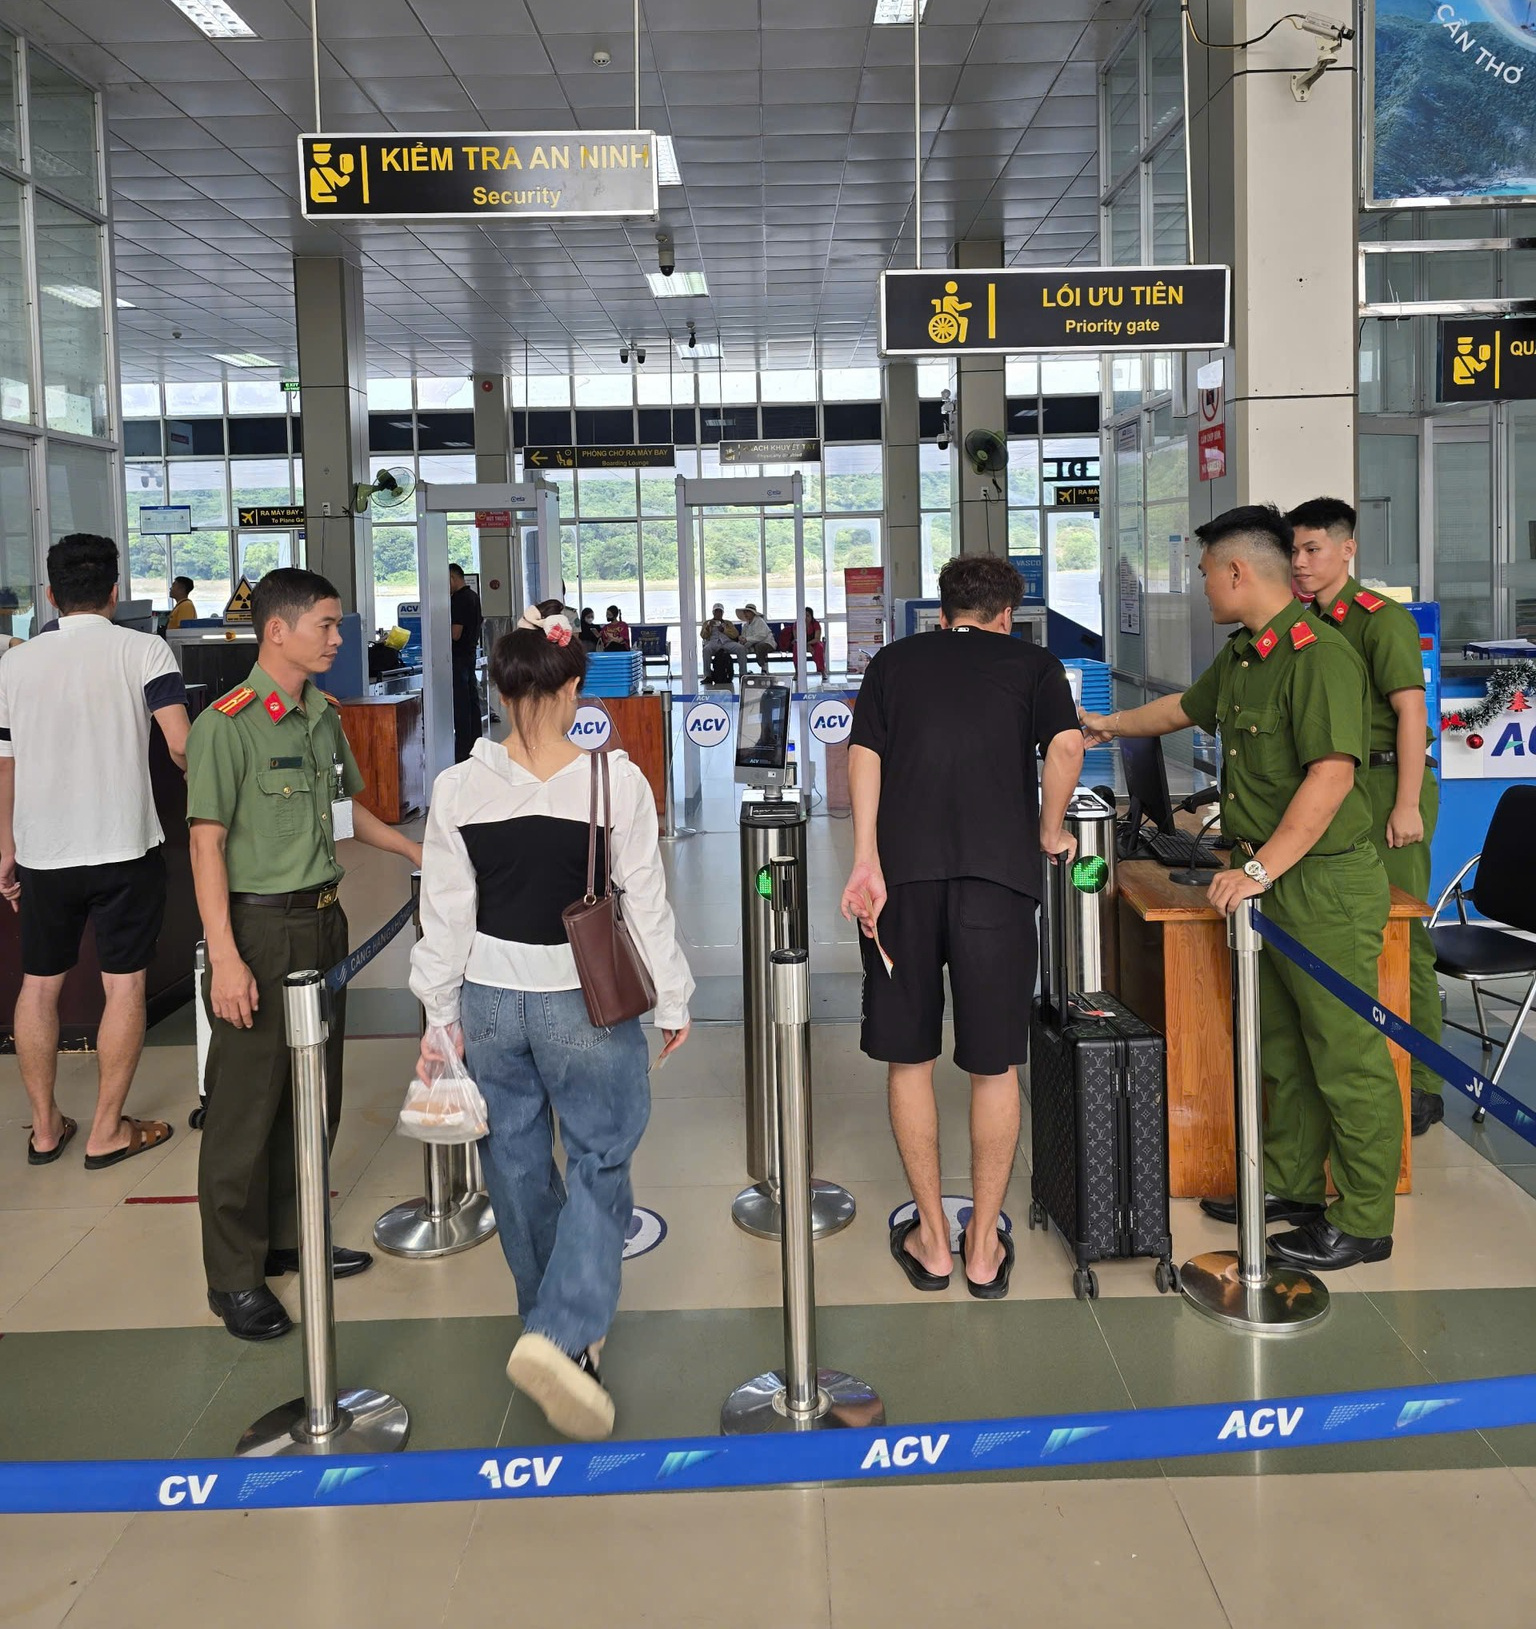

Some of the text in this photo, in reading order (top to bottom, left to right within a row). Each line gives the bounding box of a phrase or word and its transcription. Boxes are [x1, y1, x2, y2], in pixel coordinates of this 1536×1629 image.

[1437, 4, 1525, 84] CẦN THƠ
[381, 141, 650, 172] KIỂM TRA AN NINH
[473, 185, 562, 208] Security
[1042, 280, 1184, 308] LỐI ƯU TIÊN
[1065, 319, 1160, 335] Priority gate
[1510, 340, 1536, 356] QU
[638, 447, 652, 456] MÁY
[654, 448, 668, 456] BAY
[1016, 559, 1042, 567] VASCO
[400, 605, 419, 613] ACV
[570, 721, 607, 735] ACV
[689, 718, 726, 732] ACV
[814, 715, 850, 729] ACV
[1491, 722, 1536, 757] A
[1217, 1407, 1304, 1440] ACV
[861, 1434, 950, 1470] ACV
[478, 1456, 563, 1489] ACV
